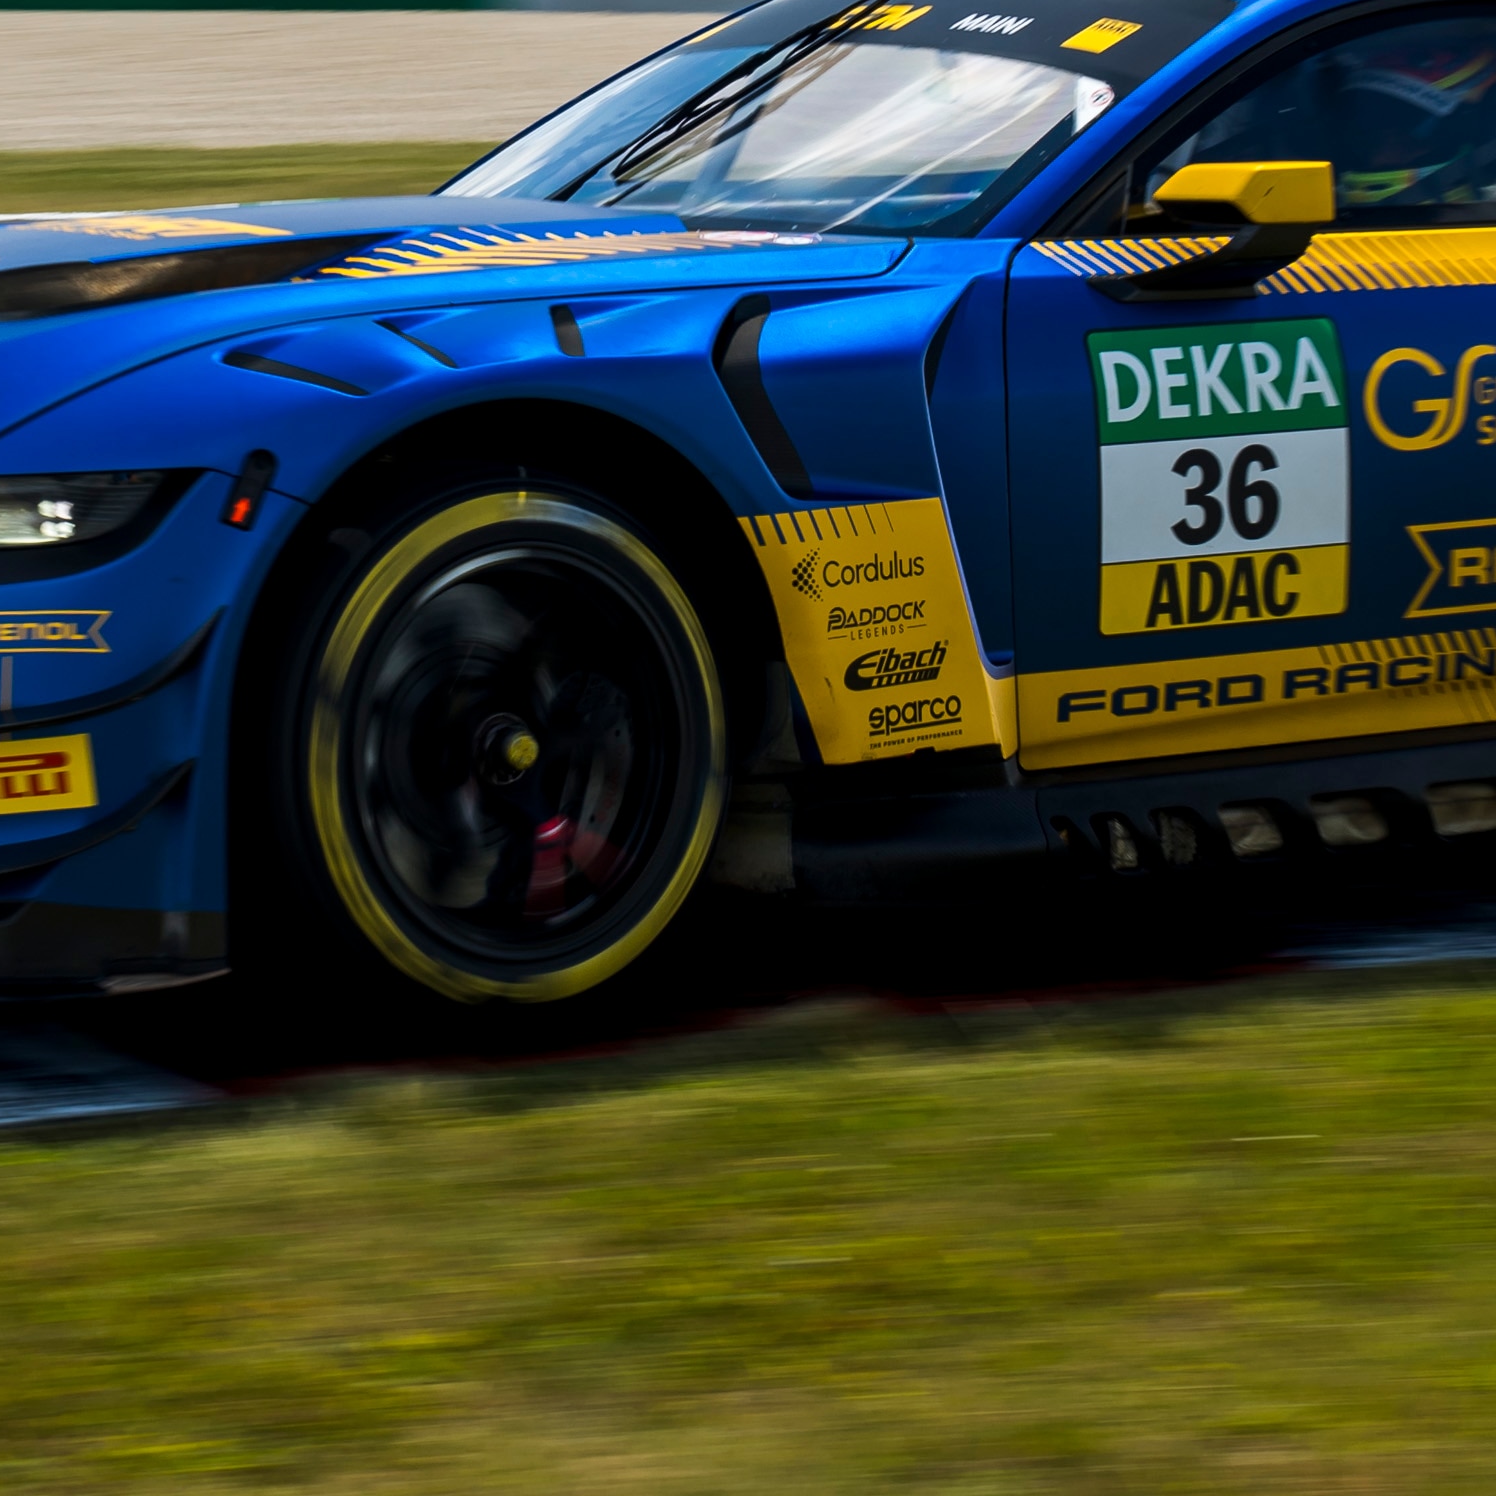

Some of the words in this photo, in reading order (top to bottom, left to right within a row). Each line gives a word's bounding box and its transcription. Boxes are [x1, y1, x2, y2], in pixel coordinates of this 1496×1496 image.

[948, 12, 1035, 35] MAINI
[1099, 337, 1341, 423] DEKRA
[1171, 443, 1280, 546] 36
[822, 551, 925, 588] Cordulus
[1145, 552, 1301, 628] ADAC
[827, 600, 926, 632] PADDOCK
[850, 624, 905, 640] LEGENDS
[844, 641, 946, 691] Eibach
[868, 695, 962, 736] sparco
[1056, 673, 1265, 723] FORD
[883, 738, 905, 748] POWER
[907, 736, 915, 744] OF
[917, 729, 963, 742] PERFORMANCE
